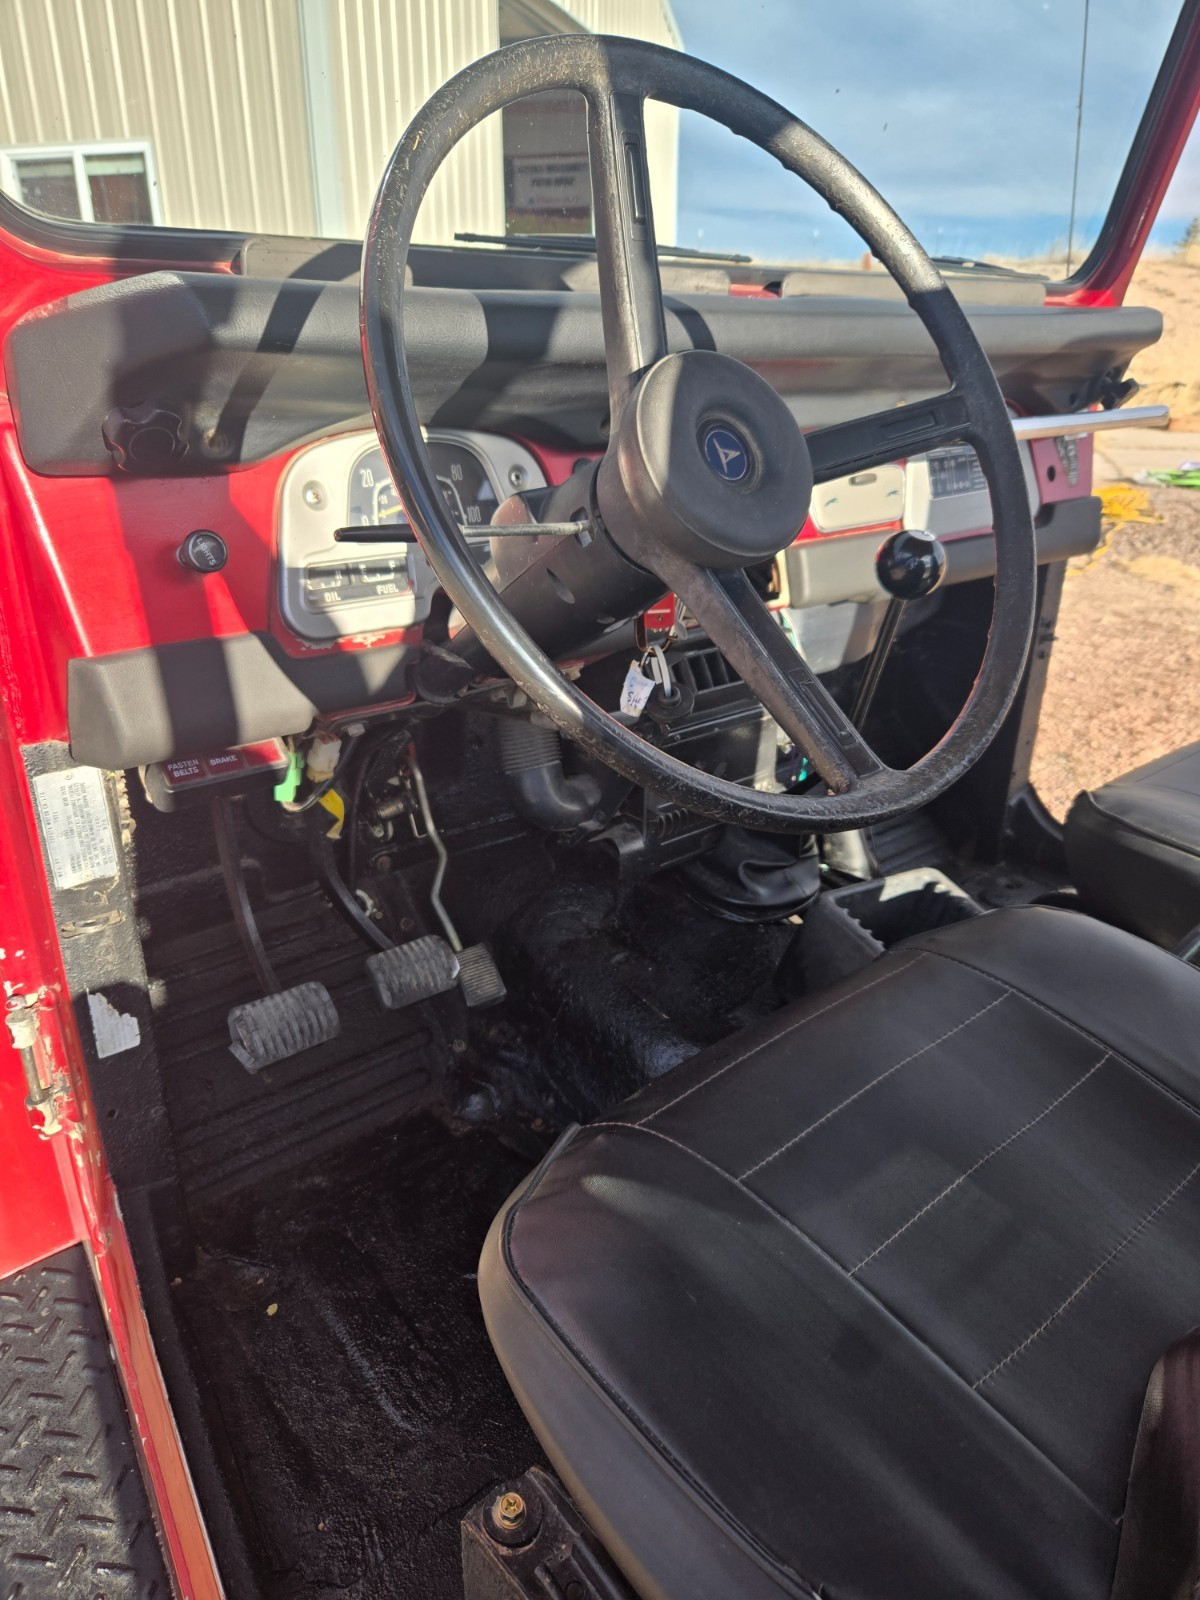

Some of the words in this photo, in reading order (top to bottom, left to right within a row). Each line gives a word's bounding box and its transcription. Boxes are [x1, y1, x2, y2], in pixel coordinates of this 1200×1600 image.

[359, 468, 374, 487] 20
[450, 464, 463, 481] 80
[467, 506, 481, 523] 100
[196, 537, 217, 566] LIGHTS
[376, 583, 399, 595] FUEL
[323, 591, 342, 603] OIL
[167, 759, 199, 771] FASTEN
[209, 755, 238, 766] BRAKE
[173, 766, 199, 778] BELTS
